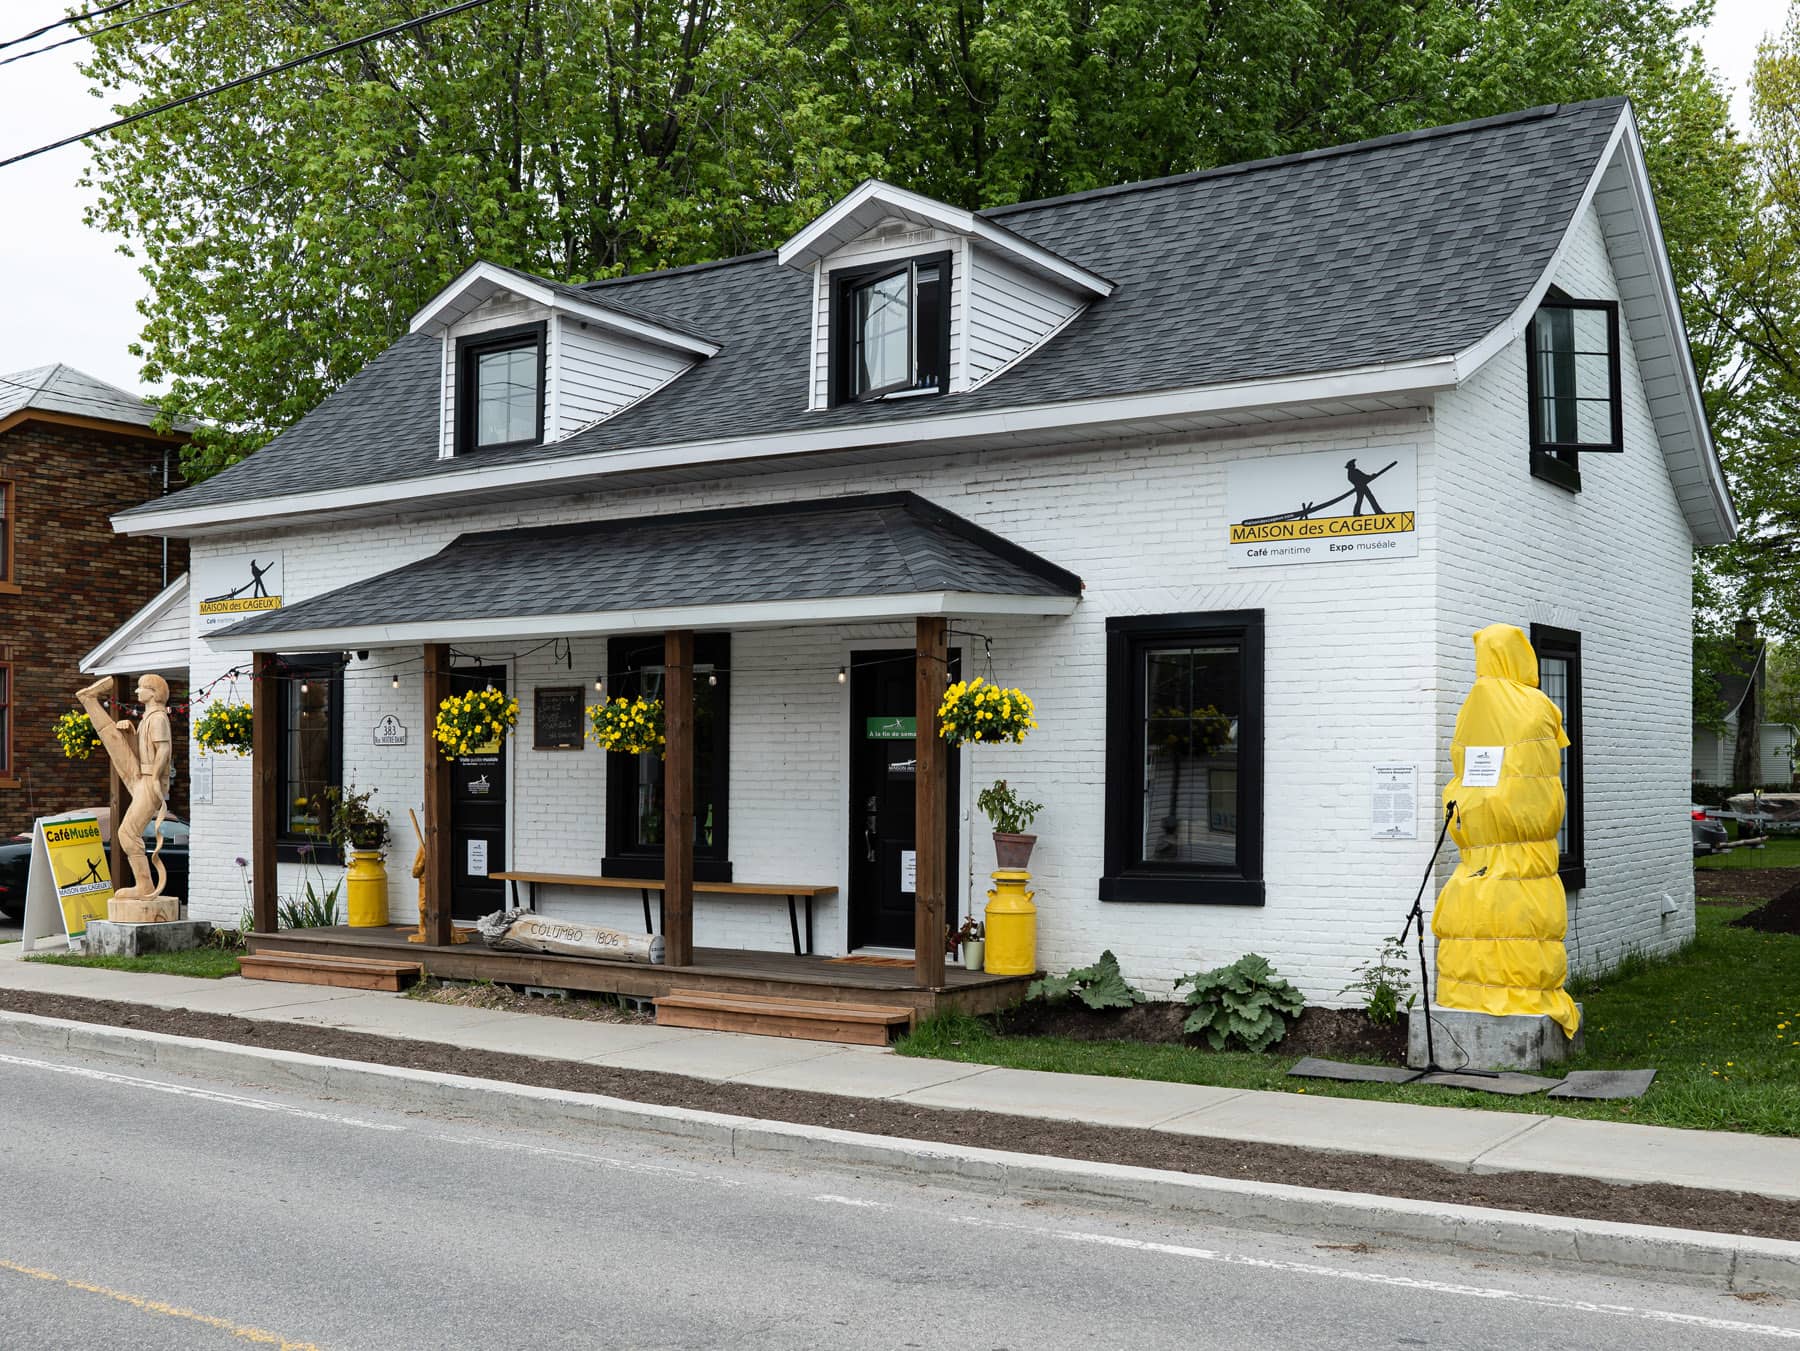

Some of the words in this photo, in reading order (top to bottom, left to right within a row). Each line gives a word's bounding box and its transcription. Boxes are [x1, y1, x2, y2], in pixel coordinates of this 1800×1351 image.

[1233, 525, 1294, 540] MAISON
[1300, 521, 1324, 535] des
[1329, 517, 1396, 534] CAGEUX
[1247, 548, 1268, 557] Café
[1270, 546, 1311, 555] maritime
[1329, 543, 1354, 553] Expo
[1356, 540, 1396, 550] muséale
[200, 602, 228, 613] MAISON
[229, 602, 241, 611] des
[242, 599, 274, 610] CAGEUX
[383, 725, 396, 736] 383
[46, 825, 100, 842] CaféMusée
[60, 886, 79, 896] MAISON
[530, 923, 583, 942] COLUMBO
[595, 931, 620, 947] 1806
